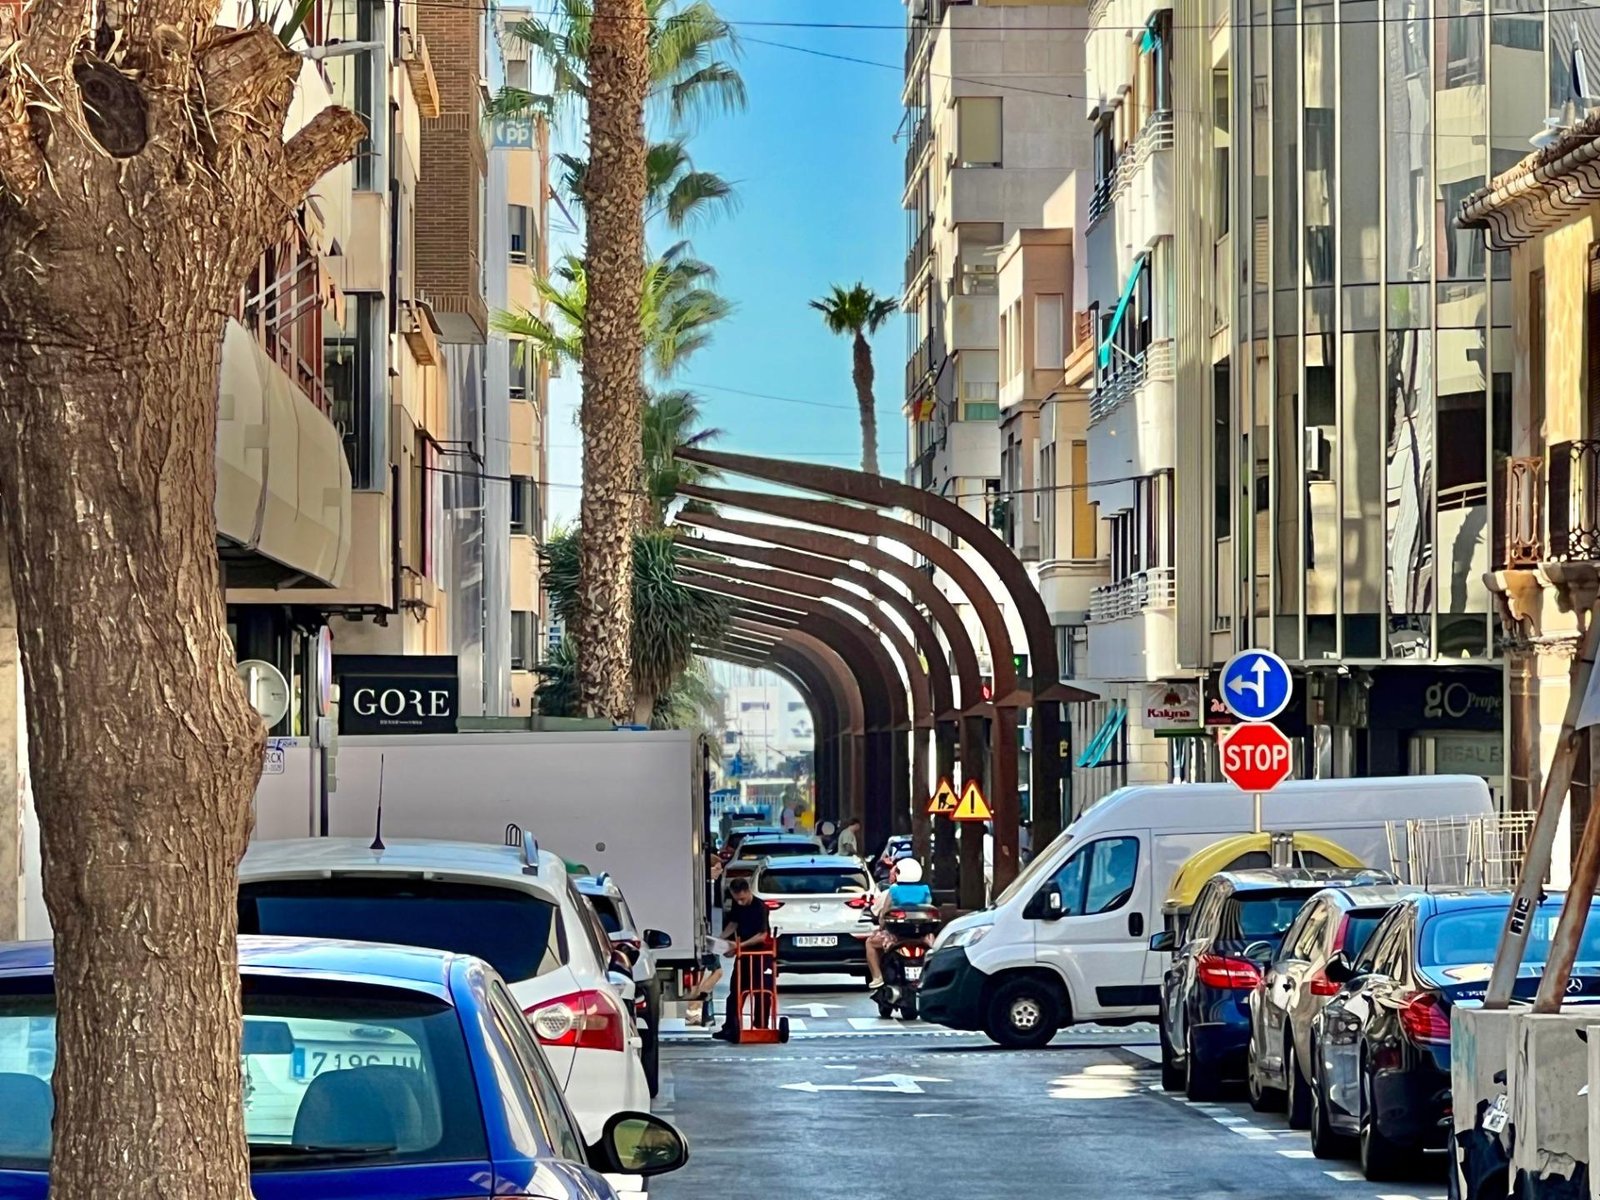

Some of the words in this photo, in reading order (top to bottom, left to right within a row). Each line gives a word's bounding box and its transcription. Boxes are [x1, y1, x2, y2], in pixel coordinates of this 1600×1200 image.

[353, 688, 450, 717] GORE
[1147, 708, 1190, 720] Kalyna
[1226, 744, 1287, 772] STOP
